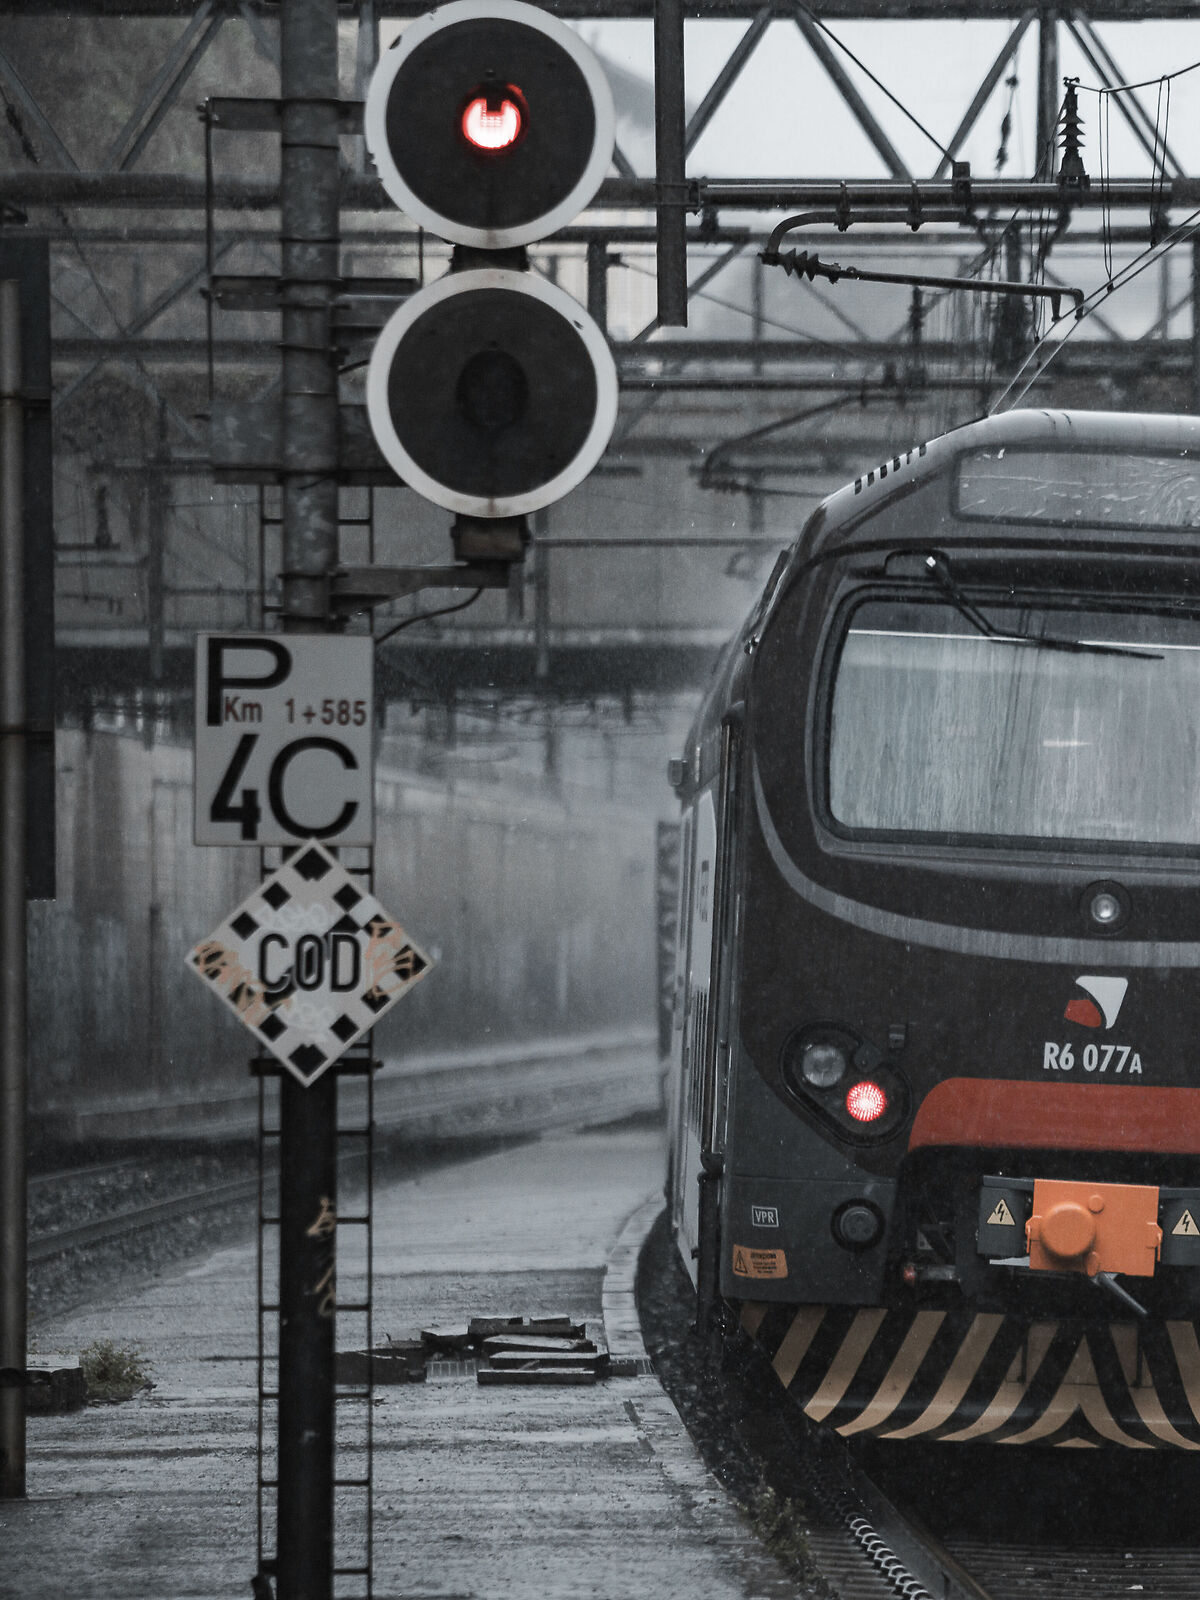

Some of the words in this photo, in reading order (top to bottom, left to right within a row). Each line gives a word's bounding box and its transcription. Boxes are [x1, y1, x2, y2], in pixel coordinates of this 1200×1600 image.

[207, 637, 292, 727] P
[223, 696, 263, 723] Km
[285, 698, 367, 726] 1+585
[1043, 1041, 1075, 1071] R6
[1082, 1044, 1143, 1074] 077A
[755, 1210, 775, 1224] VPR
